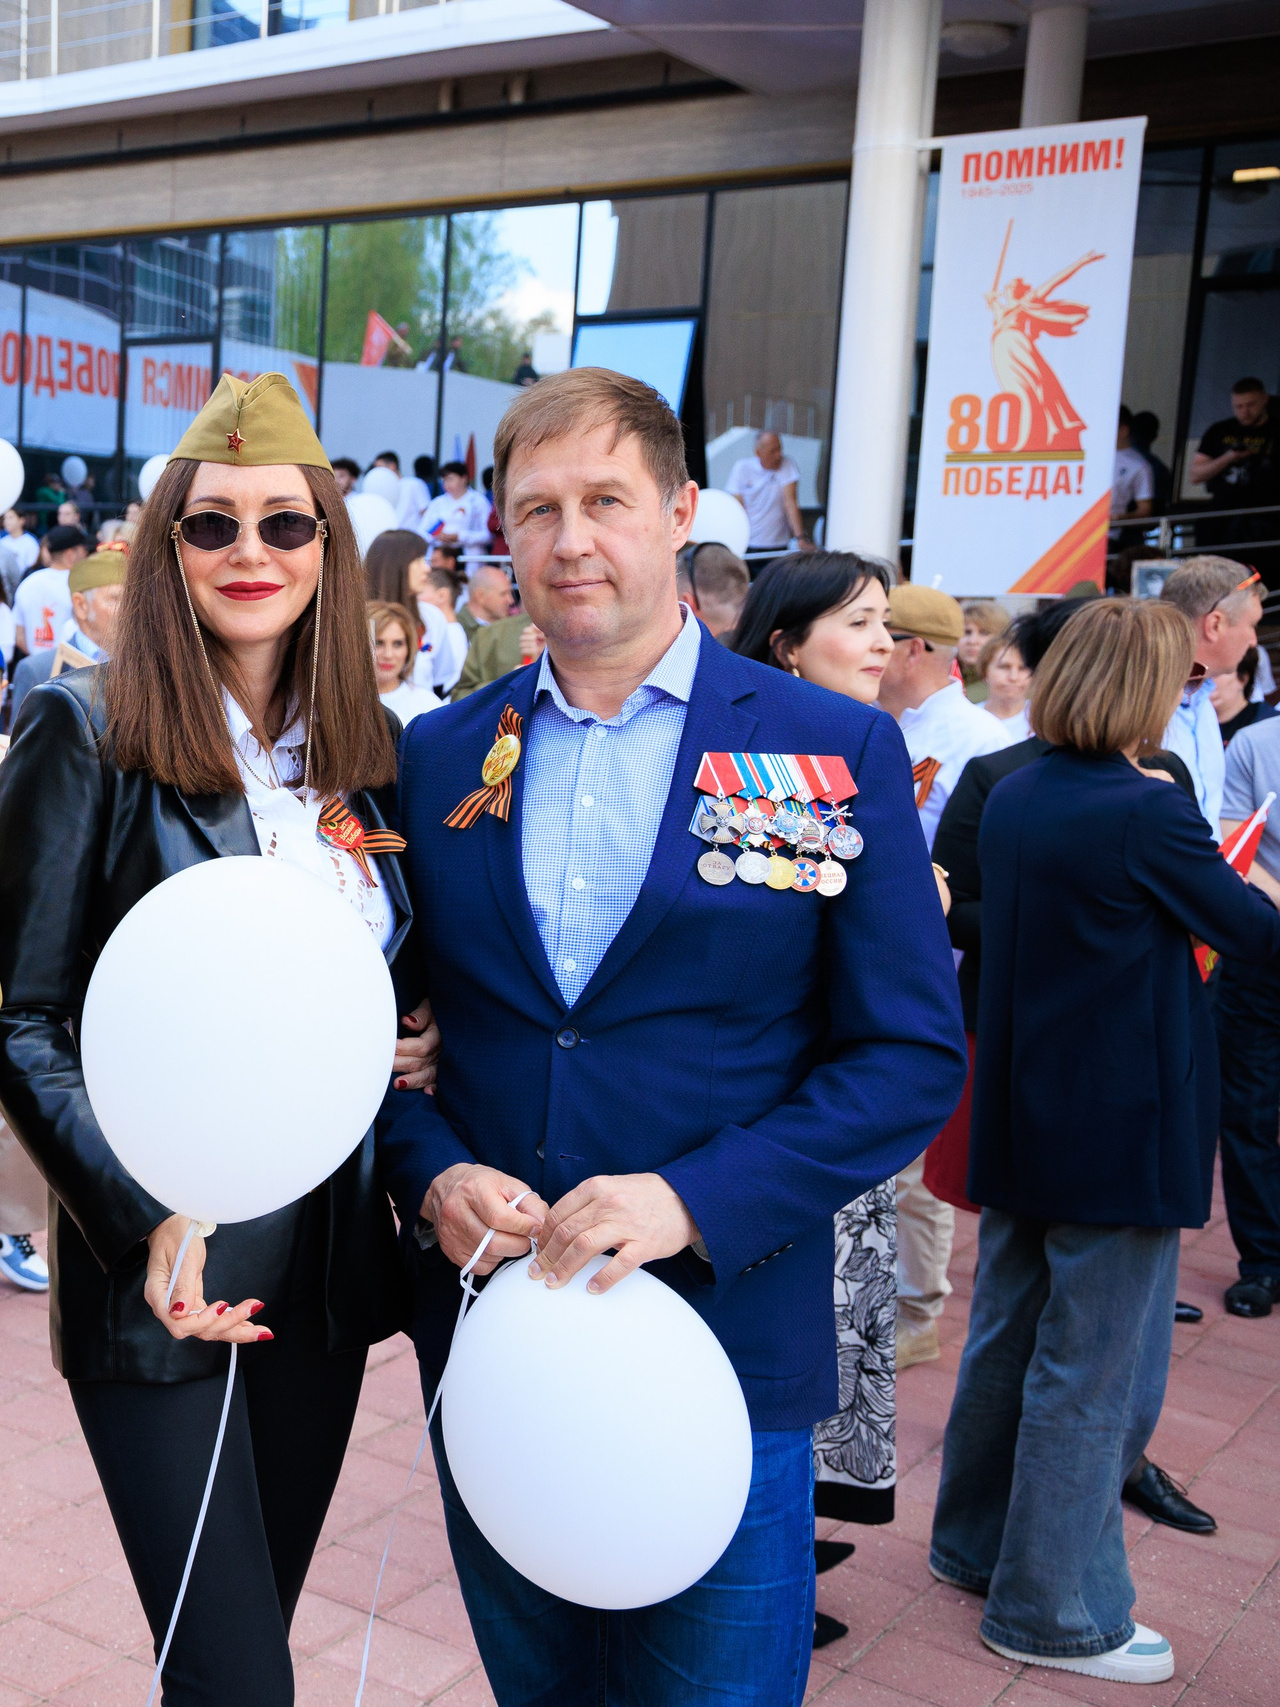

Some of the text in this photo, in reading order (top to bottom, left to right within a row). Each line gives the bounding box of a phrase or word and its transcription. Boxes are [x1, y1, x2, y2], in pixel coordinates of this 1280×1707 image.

[961, 137, 1126, 184] ПОМНИМ!
[946, 391, 1023, 453] 80
[942, 464, 1085, 501] ПОБЕДА!
